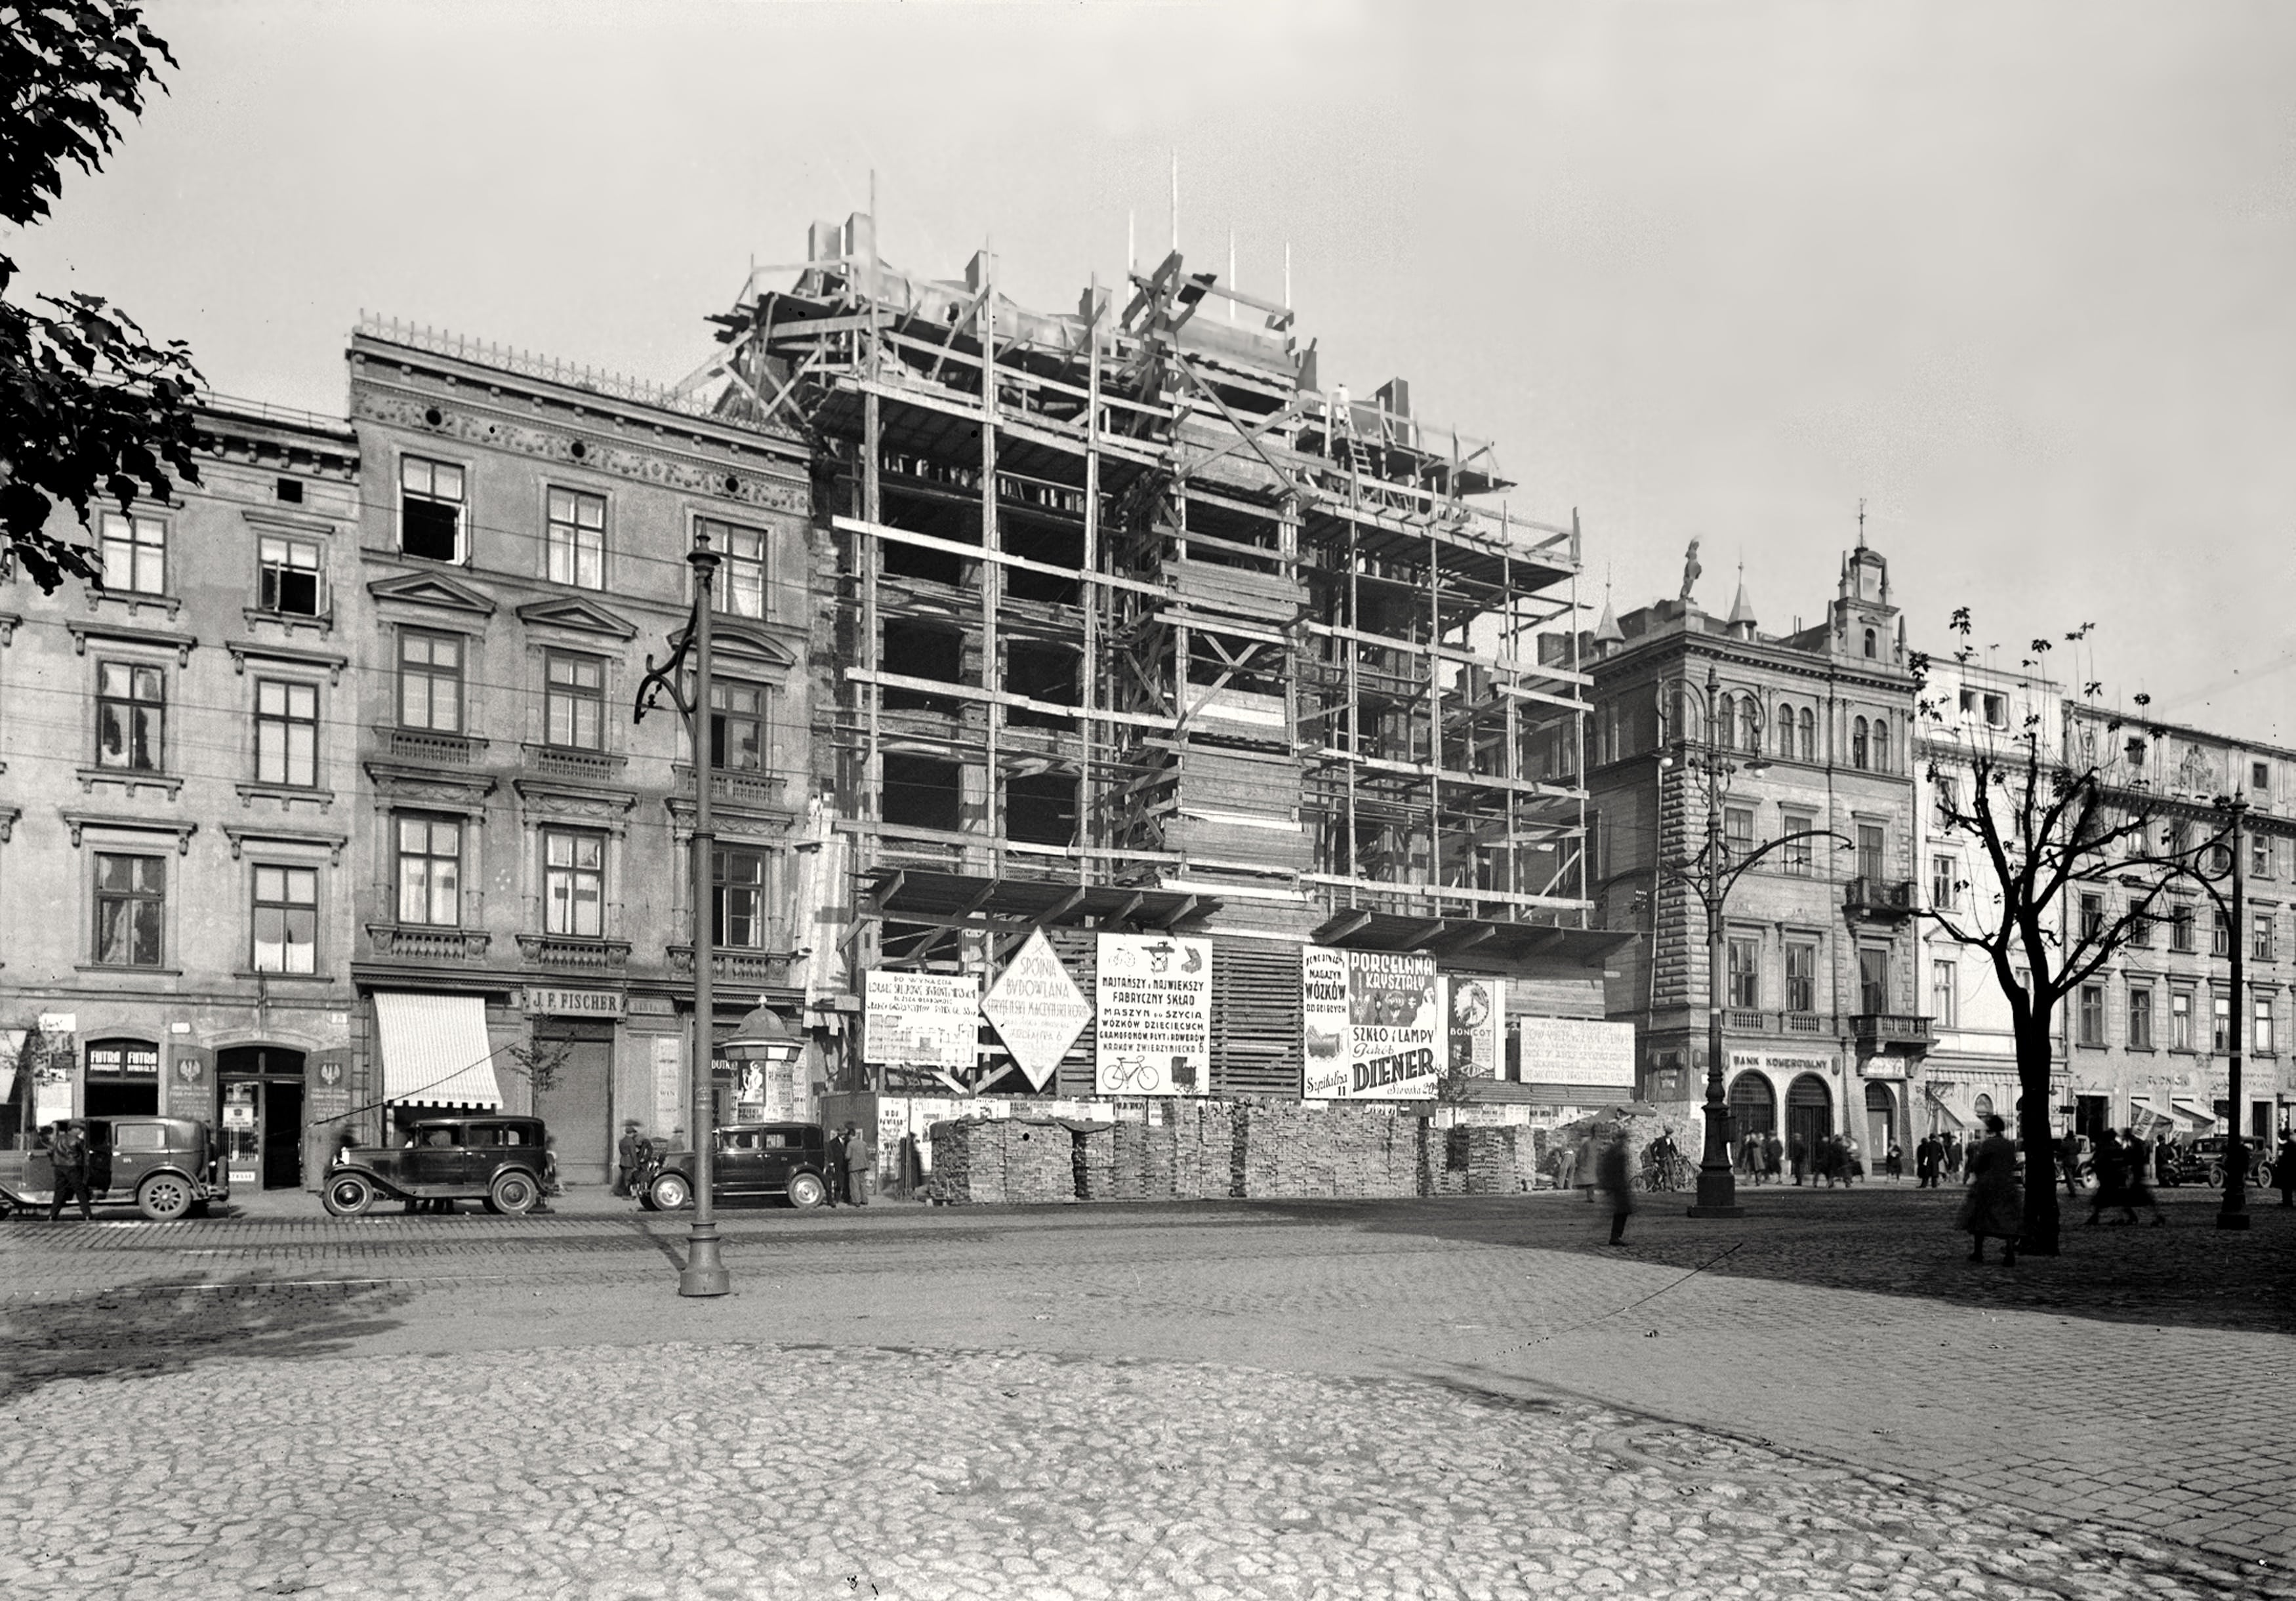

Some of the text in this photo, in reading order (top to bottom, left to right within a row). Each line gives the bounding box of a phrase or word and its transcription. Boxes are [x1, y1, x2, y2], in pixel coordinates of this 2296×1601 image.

[1350, 952, 1433, 976] PORCELANA
[1102, 975, 1147, 989] NAJTAŃSZY
[1365, 972, 1425, 991] KRYSZTAŁY
[1305, 980, 1346, 1002] WÓZKÓW
[560, 994, 617, 1011] FISCHER
[1113, 992, 1195, 1005] FABRYCZNY SKŁAD
[1104, 1008, 1150, 1017] MASZYN
[1101, 1017, 1140, 1028] WÓZKÓW
[1171, 1032, 1206, 1042] ROWERÓW
[1353, 1026, 1388, 1042] SZKŁO
[1399, 1028, 1434, 1044] LAMPY
[1137, 1043, 1195, 1053] ZWIERZYNIECKA
[91, 1050, 121, 1063] FUTRA
[127, 1051, 157, 1064] FUTRA
[1733, 1055, 1759, 1066] BANK
[1353, 1047, 1435, 1093] DIENER
[1306, 1070, 1347, 1095] Szpitalna
[1338, 1086, 1346, 1096] 11
